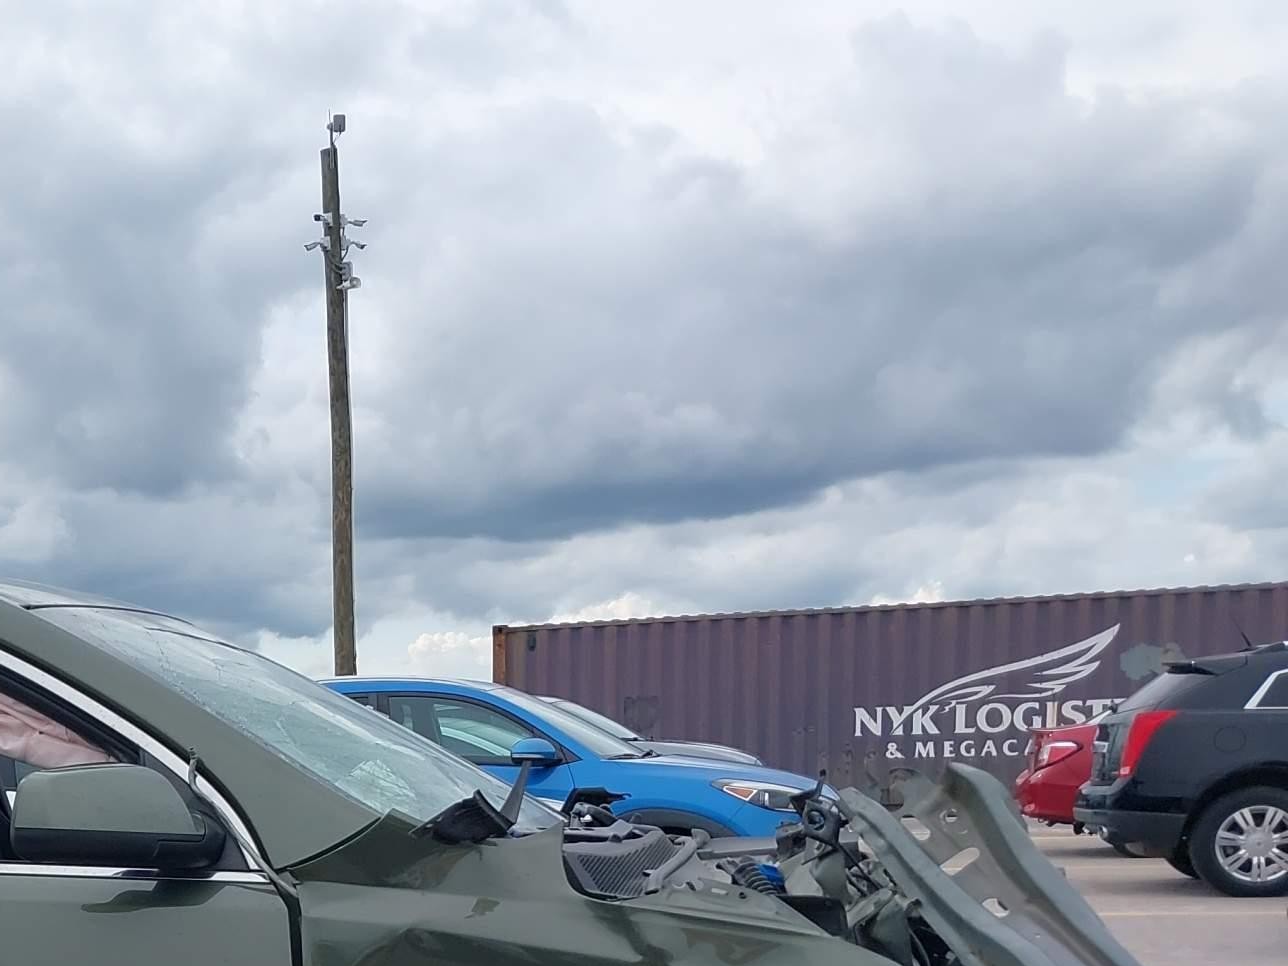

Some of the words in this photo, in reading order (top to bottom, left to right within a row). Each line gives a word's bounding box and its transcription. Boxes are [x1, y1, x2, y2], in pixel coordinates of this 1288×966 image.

[853, 703, 941, 737] NYK
[954, 698, 1127, 734] LOGIST
[885, 742, 905, 759] &
